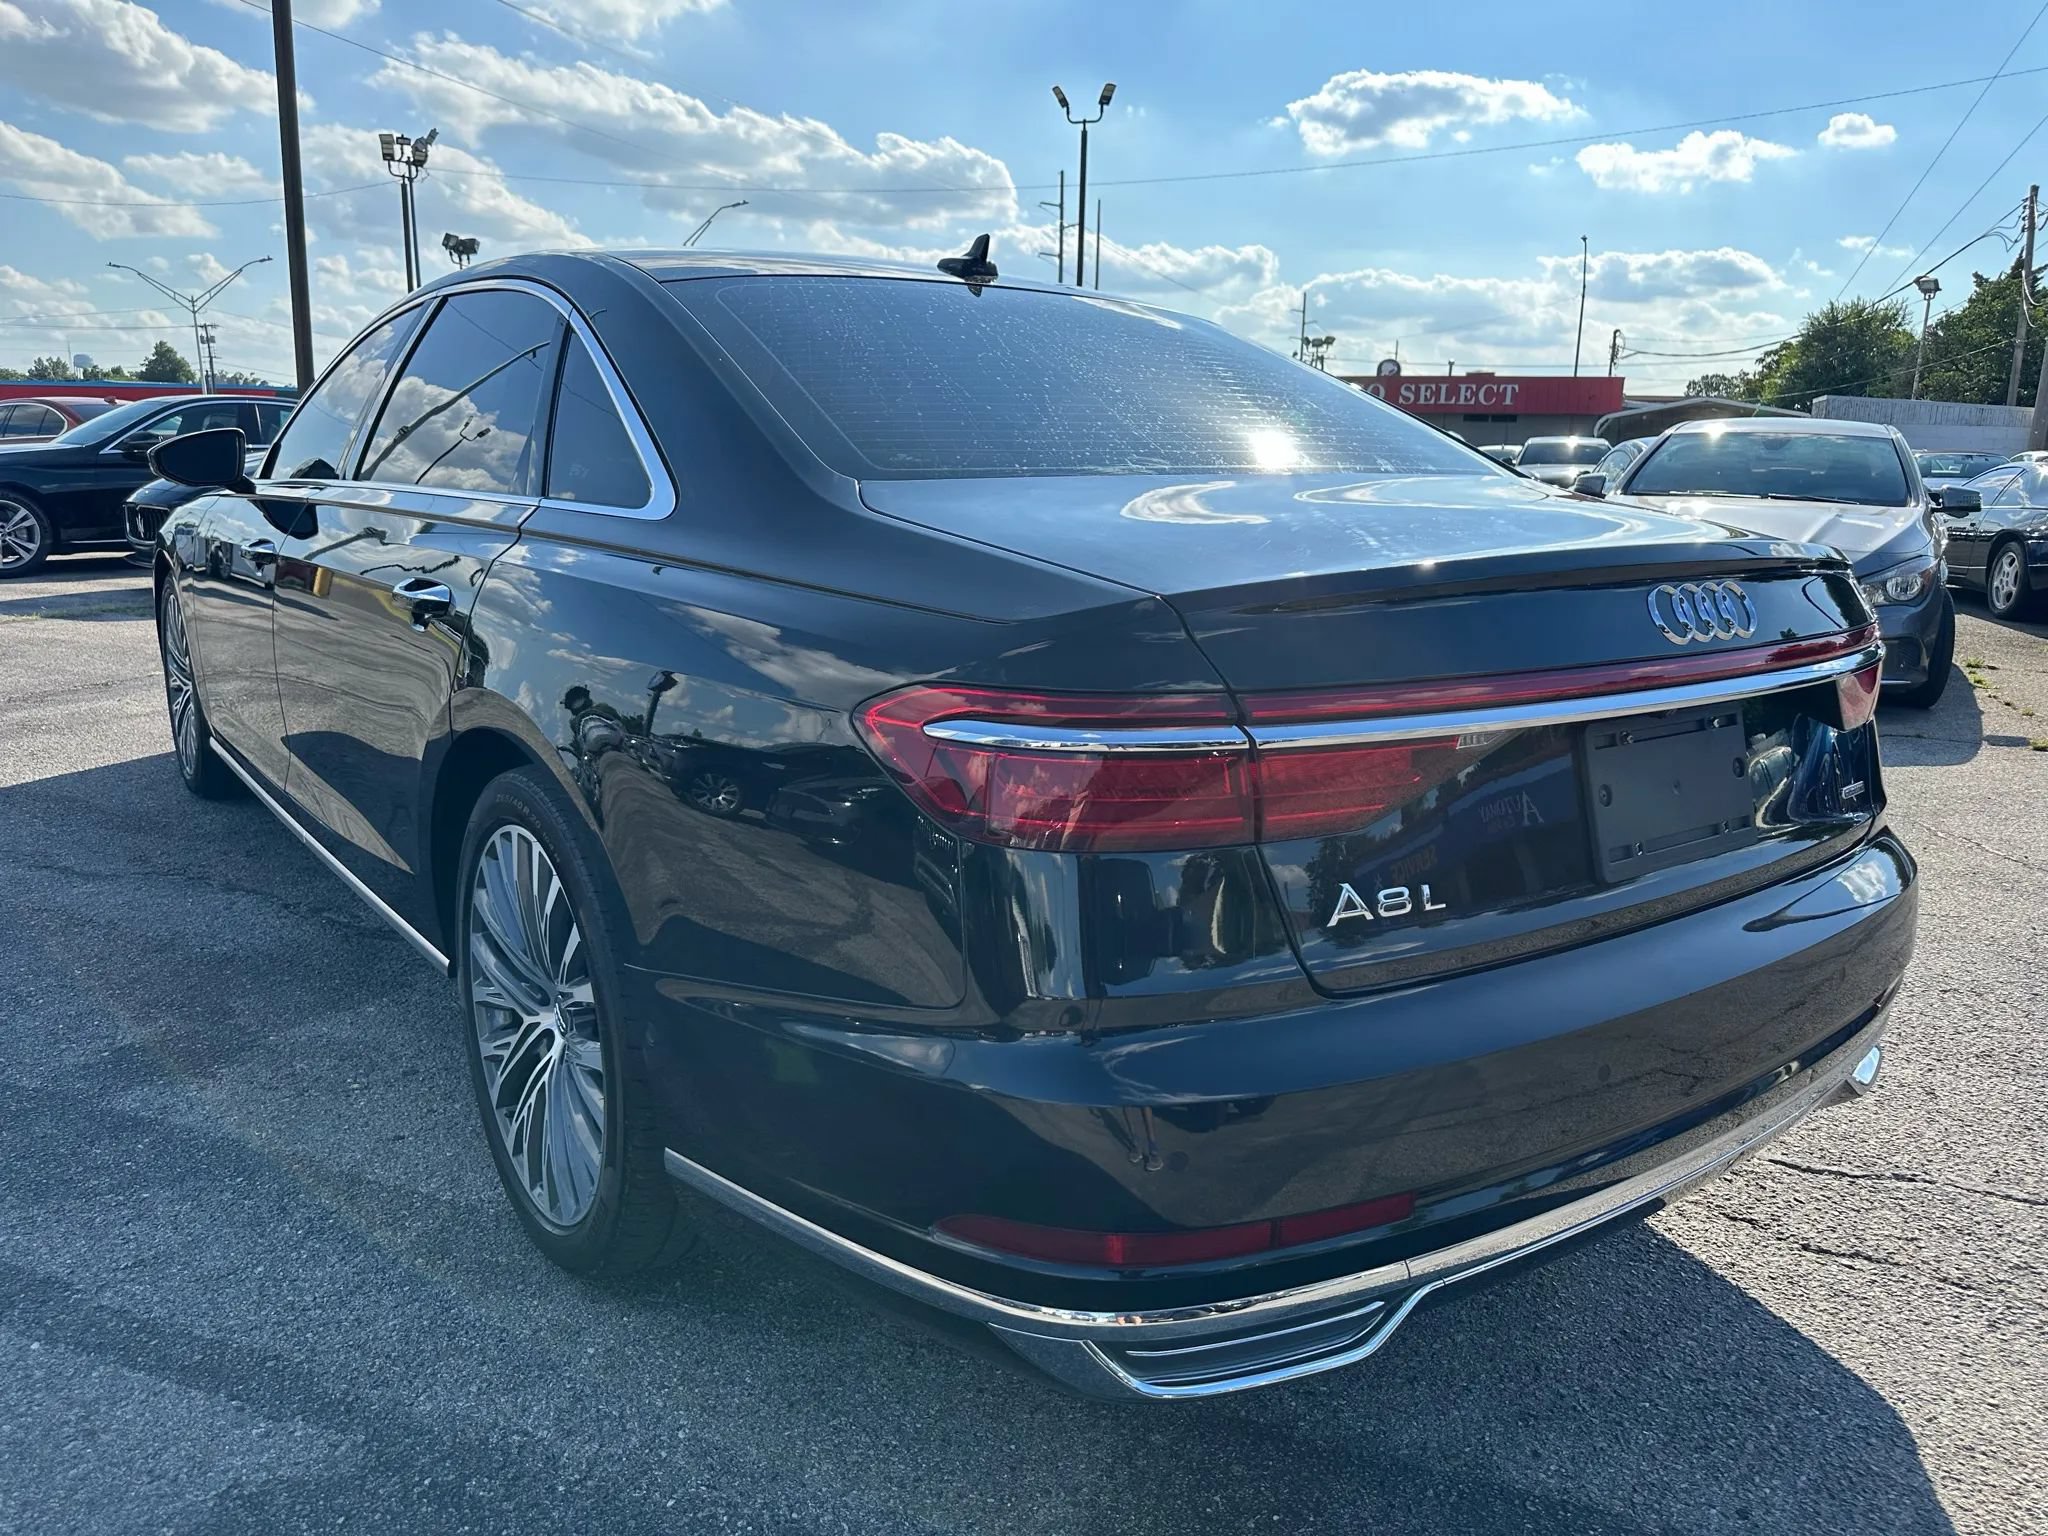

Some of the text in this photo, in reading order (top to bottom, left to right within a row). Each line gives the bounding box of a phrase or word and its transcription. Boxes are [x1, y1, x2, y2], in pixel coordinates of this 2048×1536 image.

[1398, 383, 1519, 405] SELECT
[1326, 883, 1447, 927] A8 L
